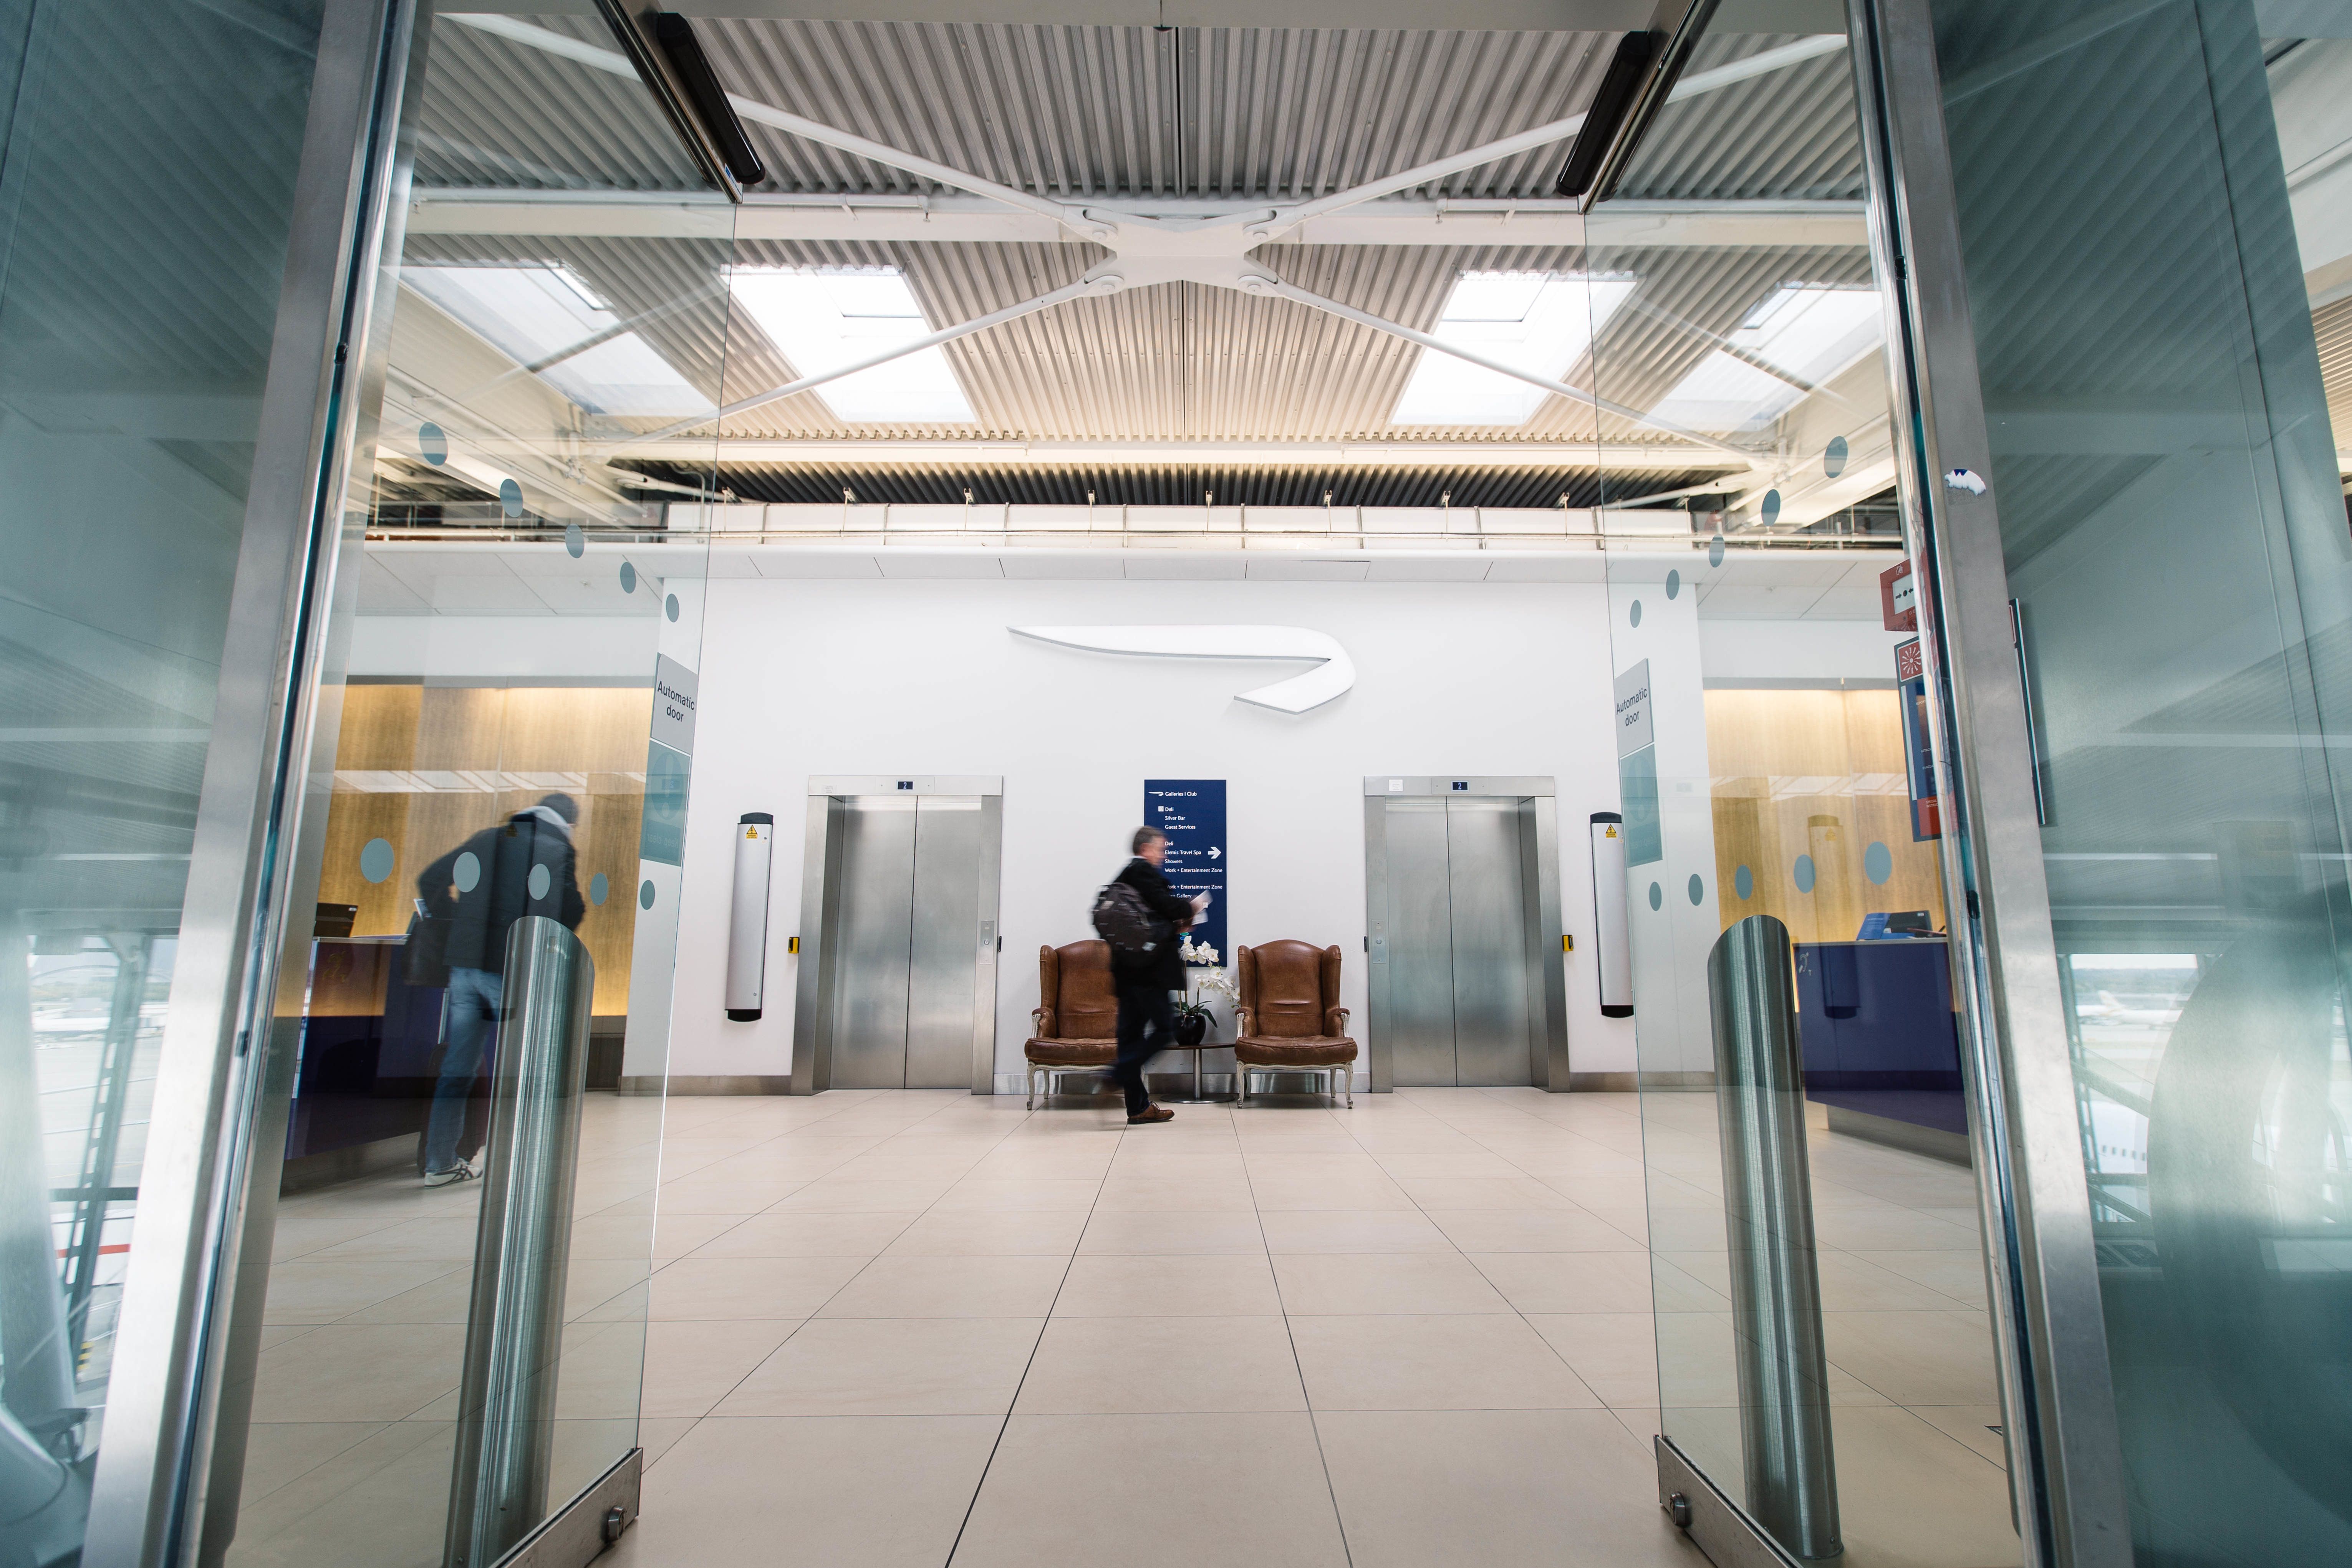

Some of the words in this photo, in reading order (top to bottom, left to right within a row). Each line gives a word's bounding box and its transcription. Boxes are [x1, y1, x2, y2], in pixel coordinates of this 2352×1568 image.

[658, 681, 695, 711] Automatic
[1616, 687, 1648, 715] Automatic
[666, 705, 684, 722] door
[1625, 711, 1640, 727] door
